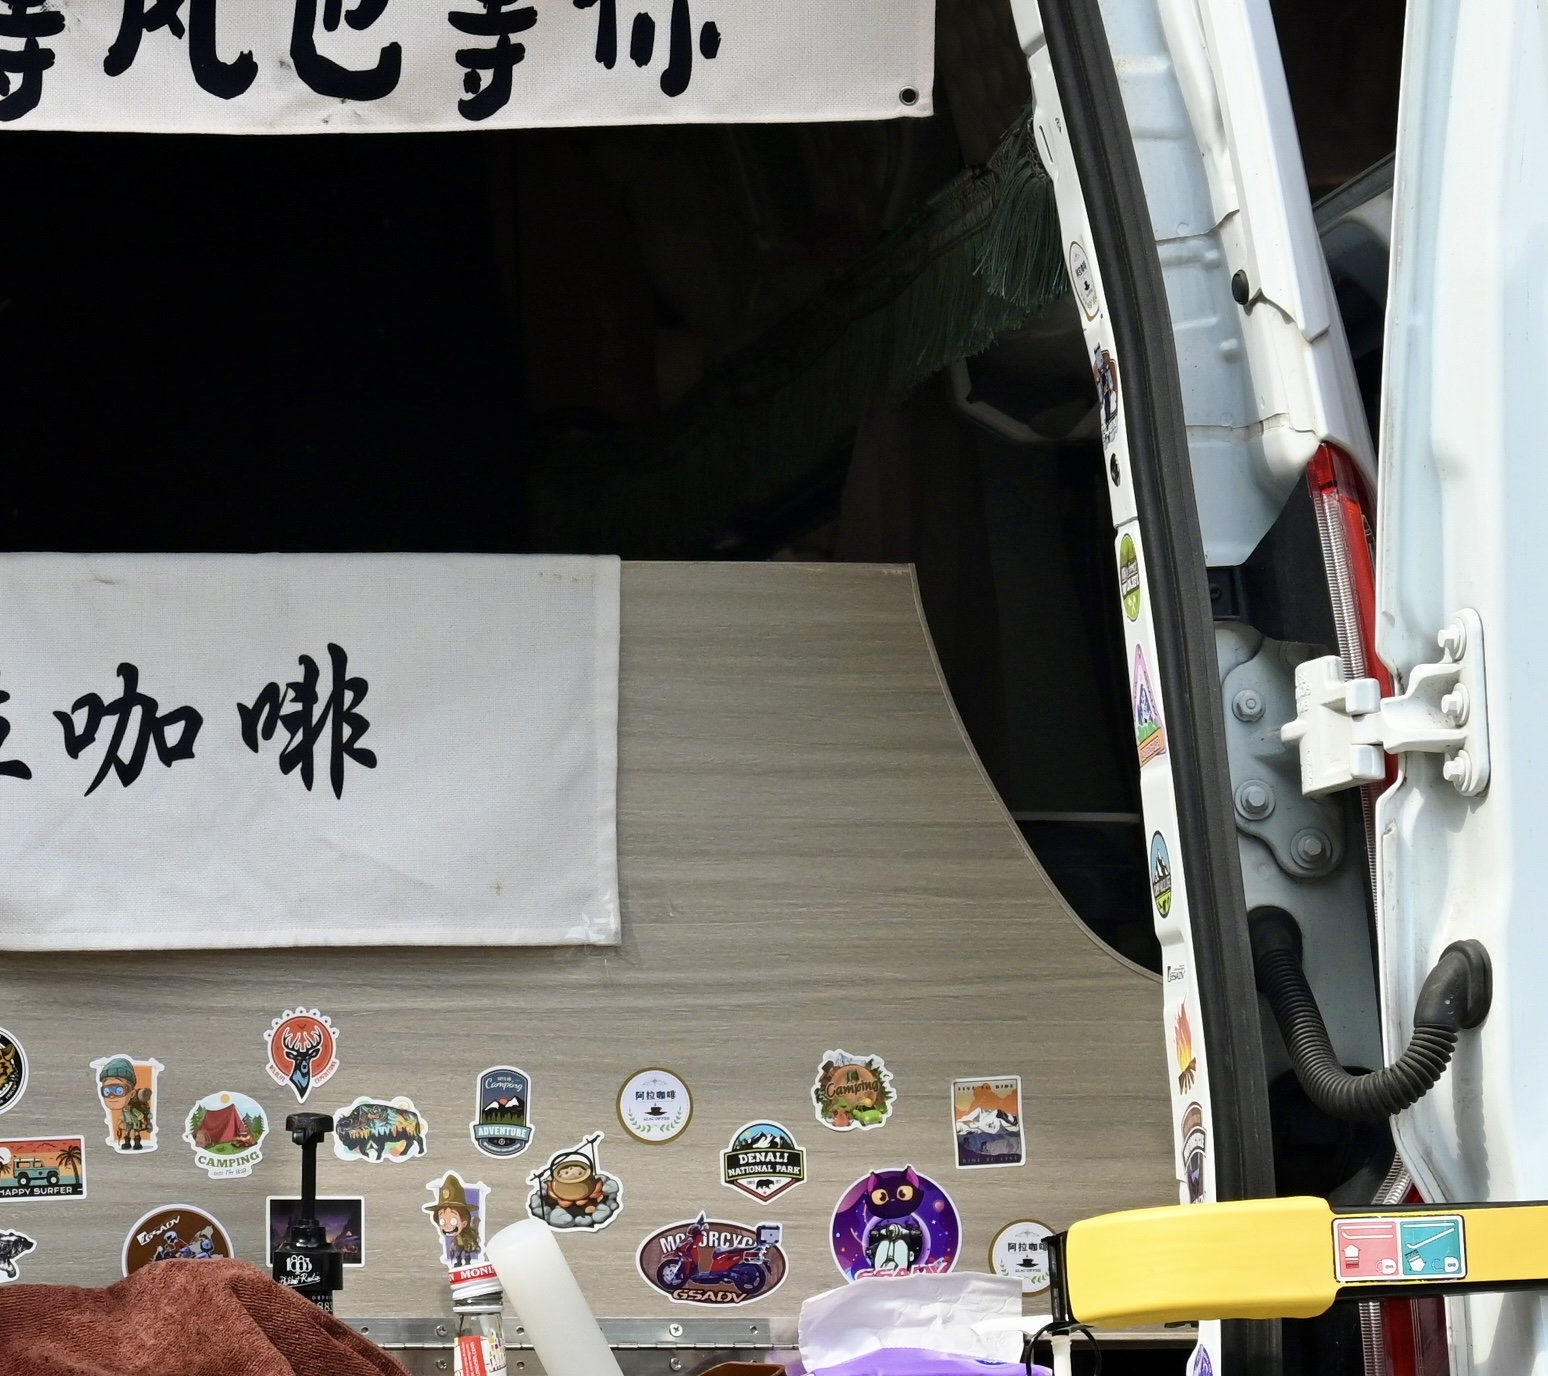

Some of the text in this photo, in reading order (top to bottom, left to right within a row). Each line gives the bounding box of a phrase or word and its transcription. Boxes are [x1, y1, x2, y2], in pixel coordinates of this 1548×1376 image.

[485, 1079, 523, 1093] Camping
[826, 1080, 878, 1100] Camping
[635, 1090, 676, 1101] 阿拉咖啡
[477, 1125, 528, 1138] ADVENTURE
[198, 1152, 260, 1168] CAMPING
[739, 1152, 788, 1165] DENALI
[728, 1164, 801, 1177] NATIONAL PARK
[33, 1184, 73, 1196] SURFER
[672, 1288, 747, 1304] GSADV
